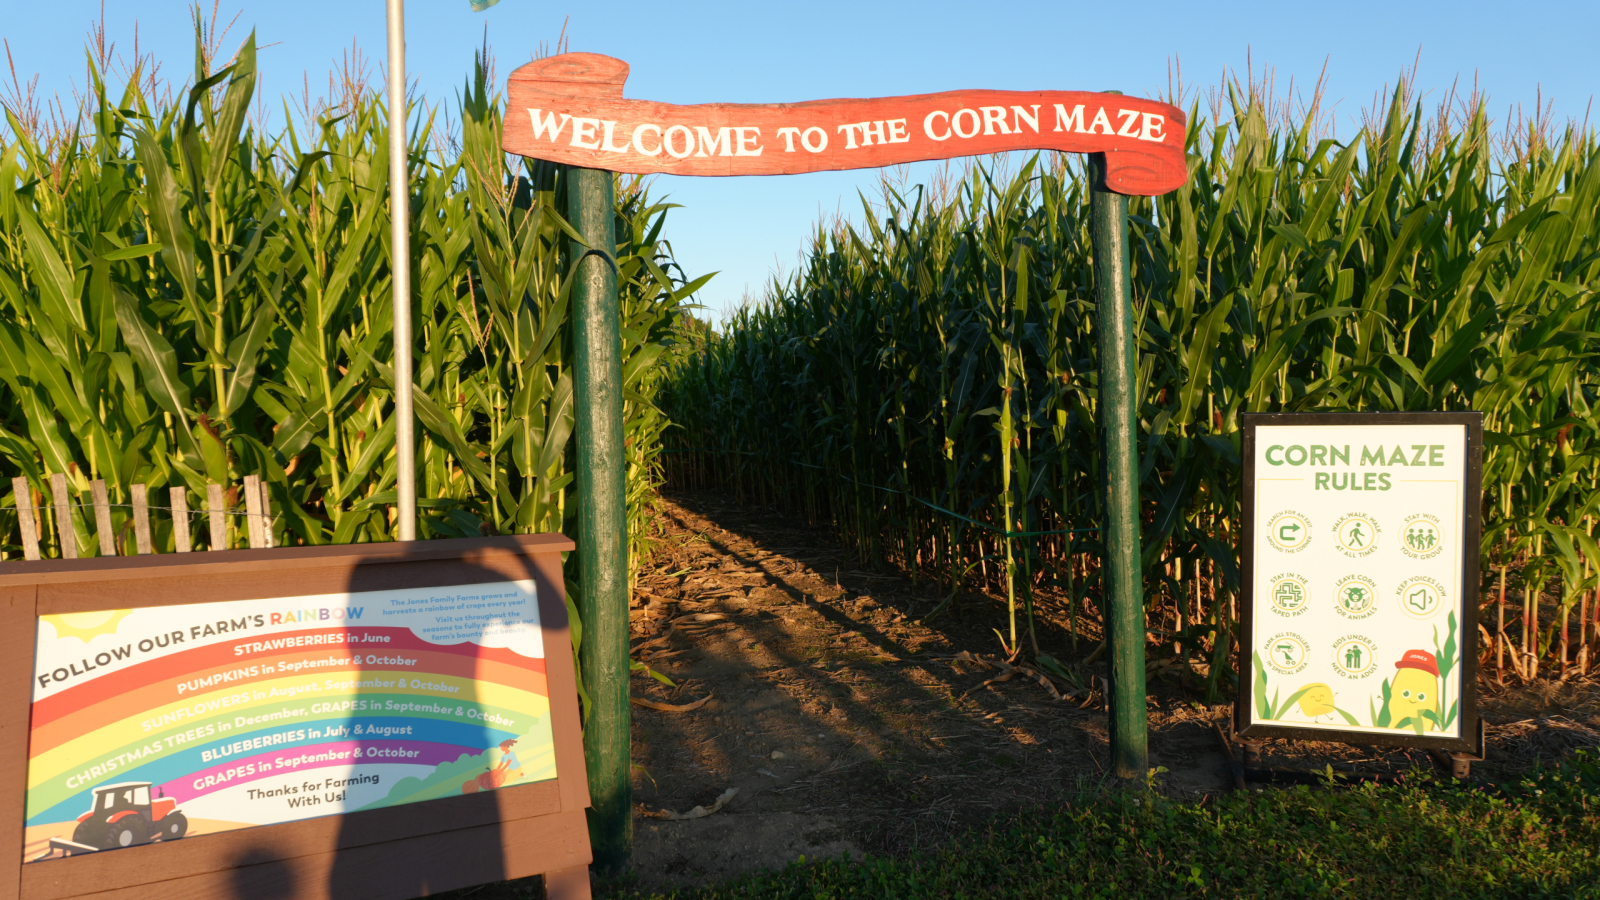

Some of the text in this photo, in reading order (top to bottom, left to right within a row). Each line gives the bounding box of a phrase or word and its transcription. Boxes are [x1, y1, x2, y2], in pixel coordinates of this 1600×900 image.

[526, 104, 1166, 158] WELCOME TO THE CORN MAZE
[1265, 444, 1445, 466] CORN MAZE
[1315, 472, 1392, 491] RULES
[1267, 511, 1283, 528] SEARCH
[1296, 512, 1305, 520] AN
[1304, 517, 1312, 528] EXIT
[1332, 515, 1348, 533] WALK,
[1369, 516, 1382, 534] WALK
[1404, 513, 1441, 524] STAY WITH
[1266, 535, 1283, 553] AROUND
[1296, 536, 1312, 552] CORNER
[1335, 544, 1378, 558] AT ALL TIMES
[1400, 545, 1444, 560] YOUR GROUP
[1270, 573, 1285, 584] STAY
[1296, 574, 1308, 584] THE
[1336, 574, 1377, 588] LEAVE CORN
[1396, 576, 1447, 597] KEEP VOICES LOW
[382, 608, 417, 616] harvests
[424, 603, 455, 613] rainbow
[457, 602, 465, 610] of
[466, 602, 486, 612] crops
[486, 600, 507, 609] every
[508, 598, 526, 608] year!
[406, 598, 428, 606] Jones
[430, 596, 455, 606] Family
[456, 594, 480, 602] Farms
[481, 592, 503, 602] grows
[464, 612, 504, 622] throughout
[506, 610, 520, 618] the
[1270, 606, 1308, 618] TAPED PATH
[1334, 605, 1378, 620] FOR ANIMALS
[431, 626, 527, 641] farm's bounty and beauty.
[464, 620, 481, 632] fully
[482, 620, 521, 630] experience
[38, 606, 364, 688] FOLLOW OUR FARM'S RAINBOW
[234, 632, 391, 656] STRAWBERRIES in June
[1264, 632, 1311, 652] PARK ALL STROLLERS
[1332, 634, 1378, 651] KIDS UNDER 13
[176, 654, 418, 694] PUMPKINS in September & October
[1266, 660, 1308, 675] IN SPECIAL AREA
[1331, 662, 1346, 676] NEED
[1360, 662, 1379, 679] ADULT
[141, 678, 460, 732] SUNFLOWERS in August, September & October
[66, 699, 515, 789] CHRISTMAS TREES in December, GRAPES in September & October
[202, 724, 412, 763] BLUEBERRIES in July & August
[193, 746, 420, 790] GRAPES in September & October
[248, 773, 380, 800] Thanks for Farming
[288, 790, 347, 809] With Us!
